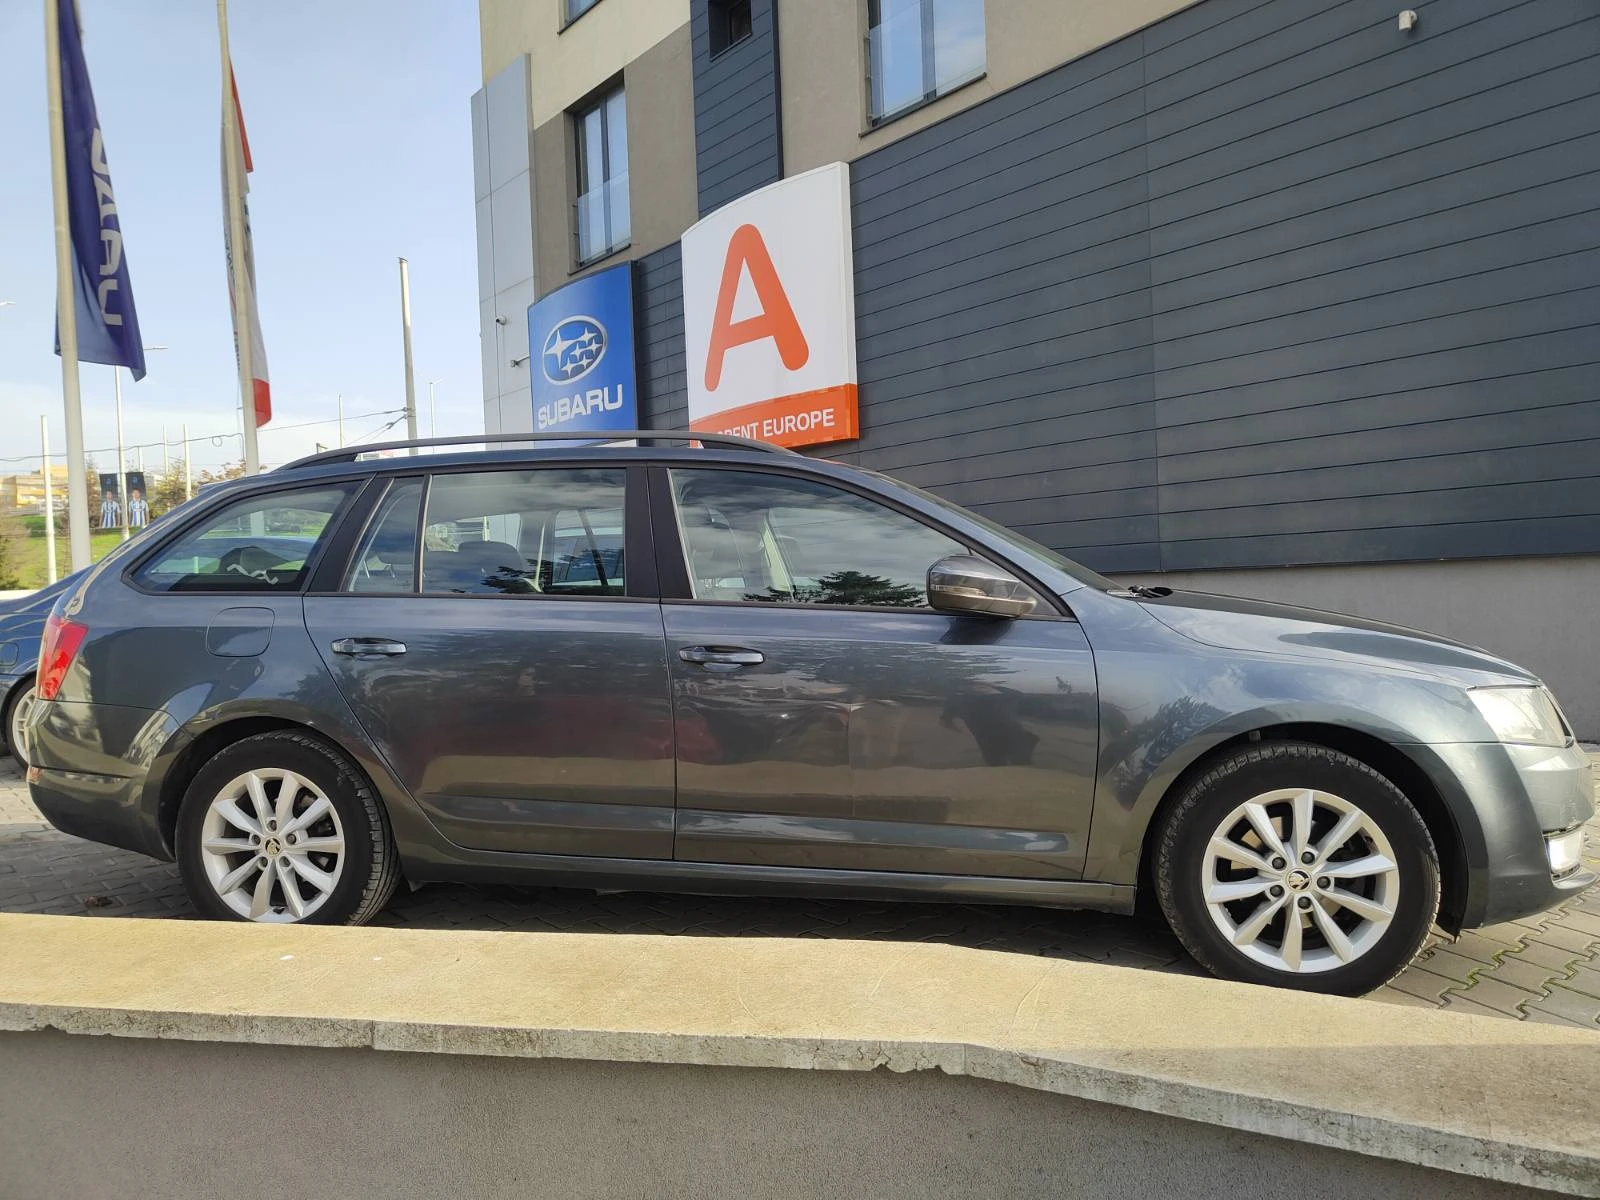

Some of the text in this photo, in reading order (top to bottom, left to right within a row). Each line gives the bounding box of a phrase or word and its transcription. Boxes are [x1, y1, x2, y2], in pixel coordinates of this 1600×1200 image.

[705, 223, 809, 392] A
[538, 384, 623, 430] SUBARU
[763, 408, 835, 437] EUROPE
